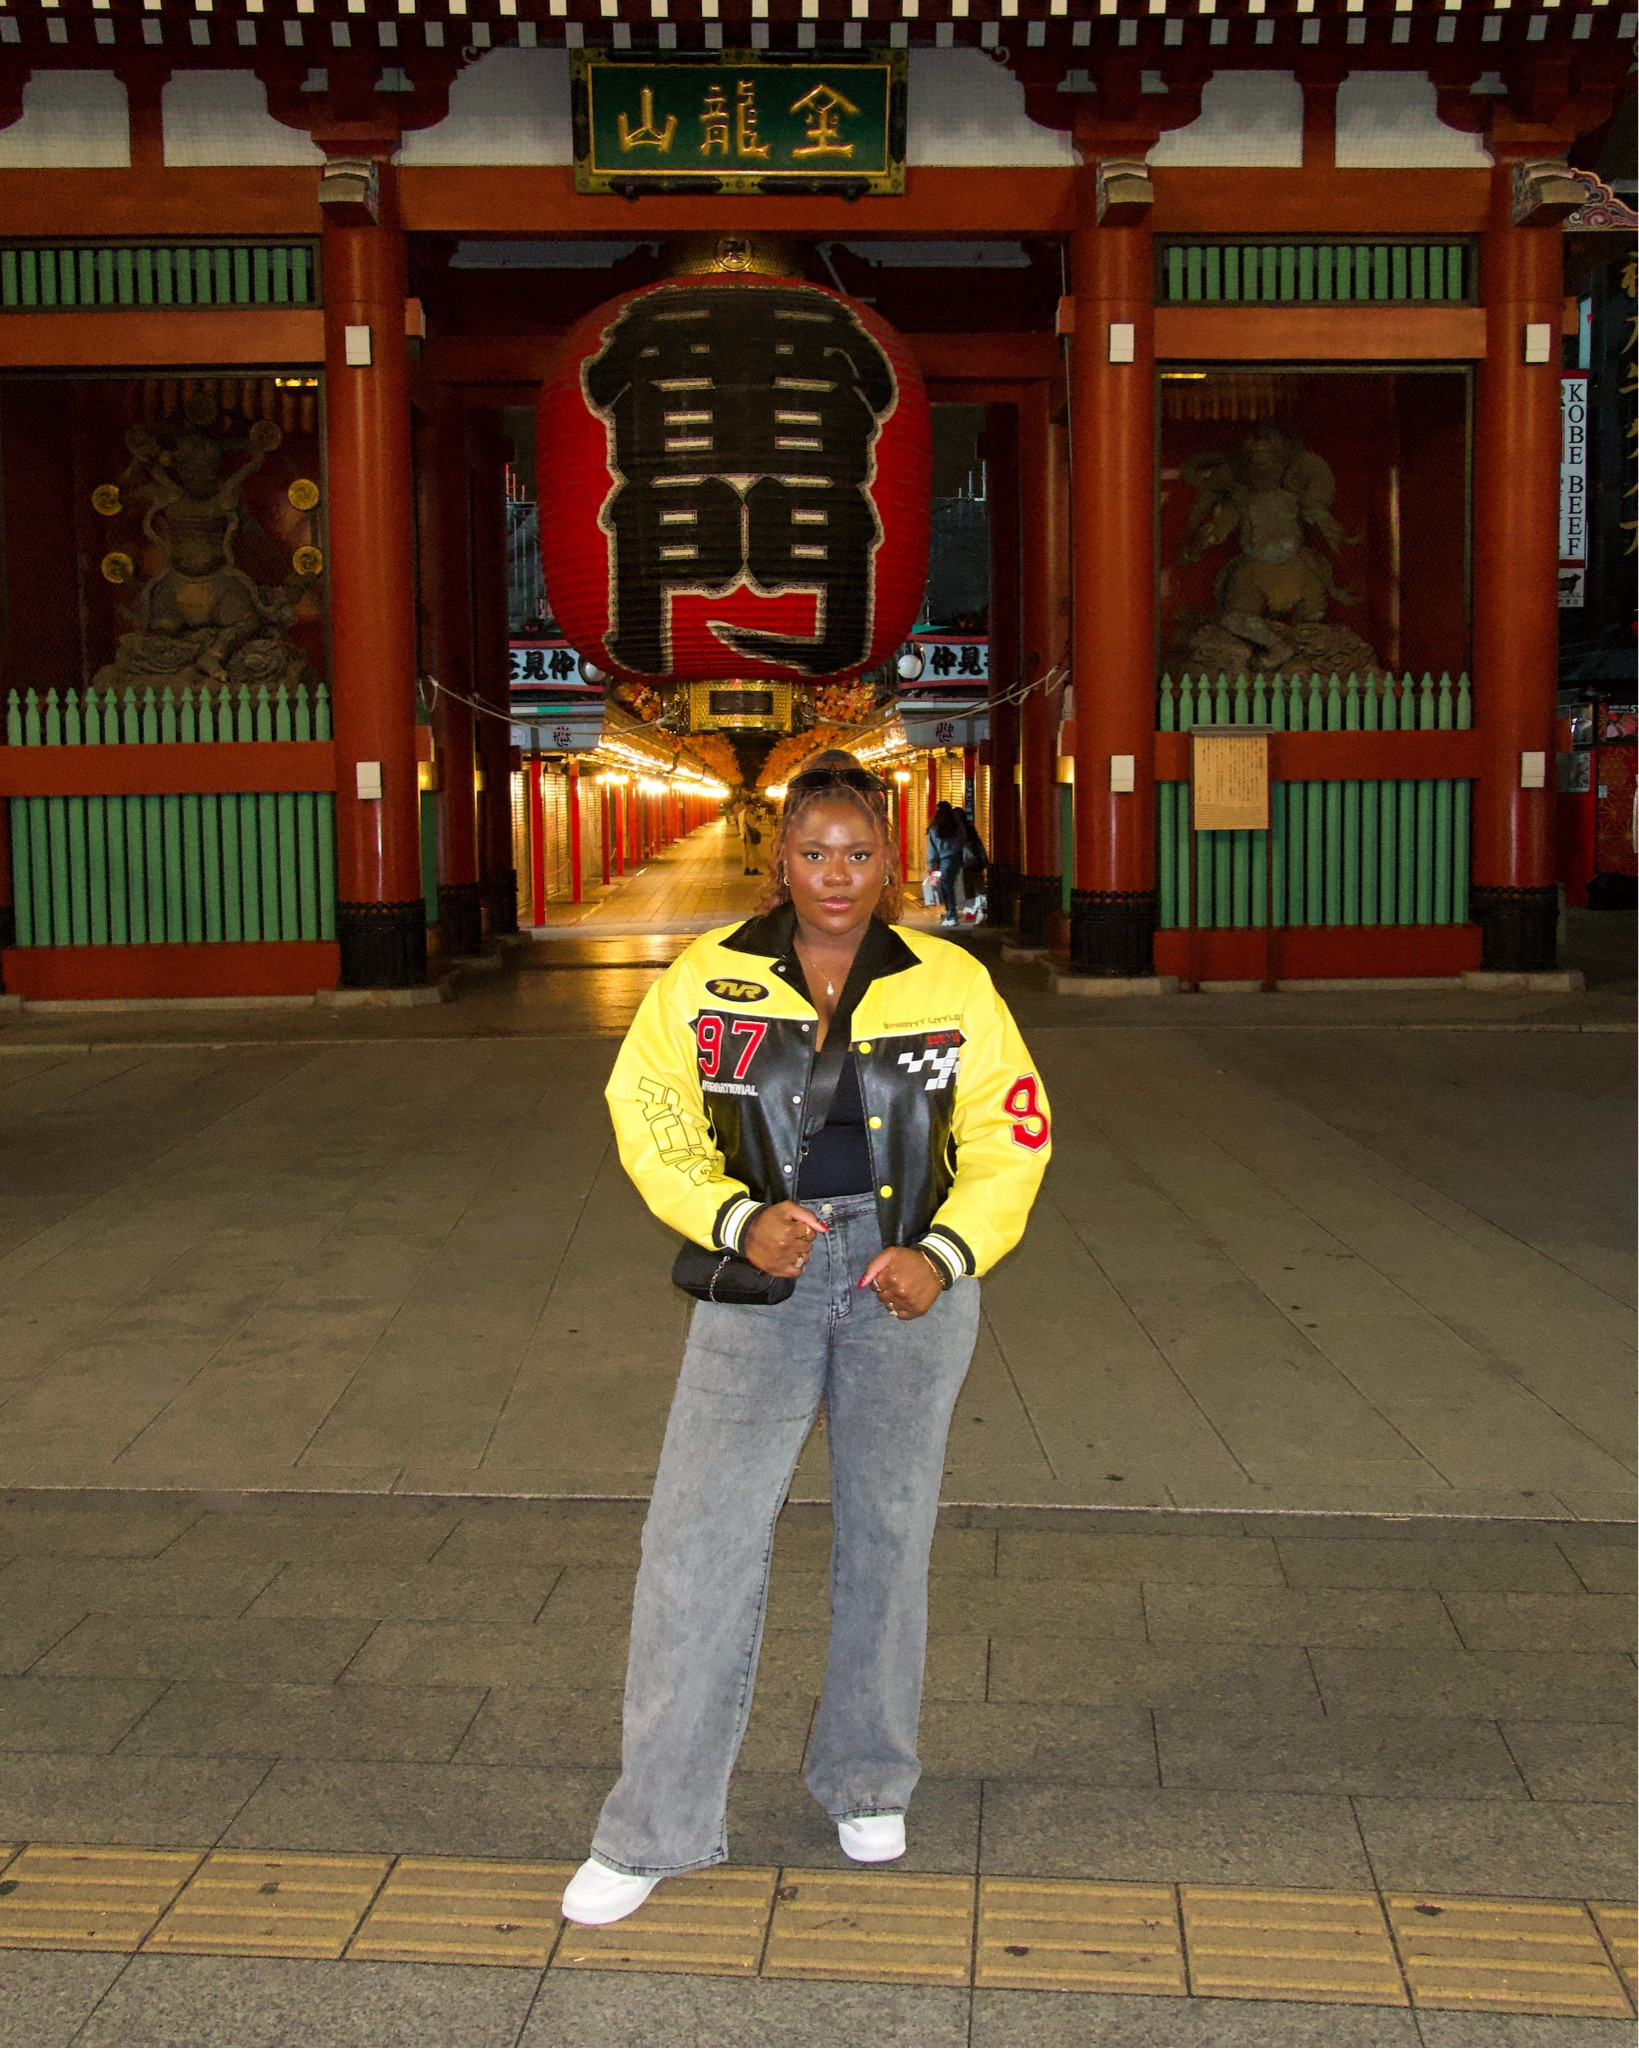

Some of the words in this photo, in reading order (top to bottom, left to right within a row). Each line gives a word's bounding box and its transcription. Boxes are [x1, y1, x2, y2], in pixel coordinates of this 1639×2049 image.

[1567, 383, 1585, 465] KOBE
[579, 283, 900, 677] 雷門
[1566, 475, 1584, 556] BEEF
[714, 980, 763, 1000] TVR
[697, 1014, 768, 1079] 97
[1002, 1072, 1050, 1153] 9
